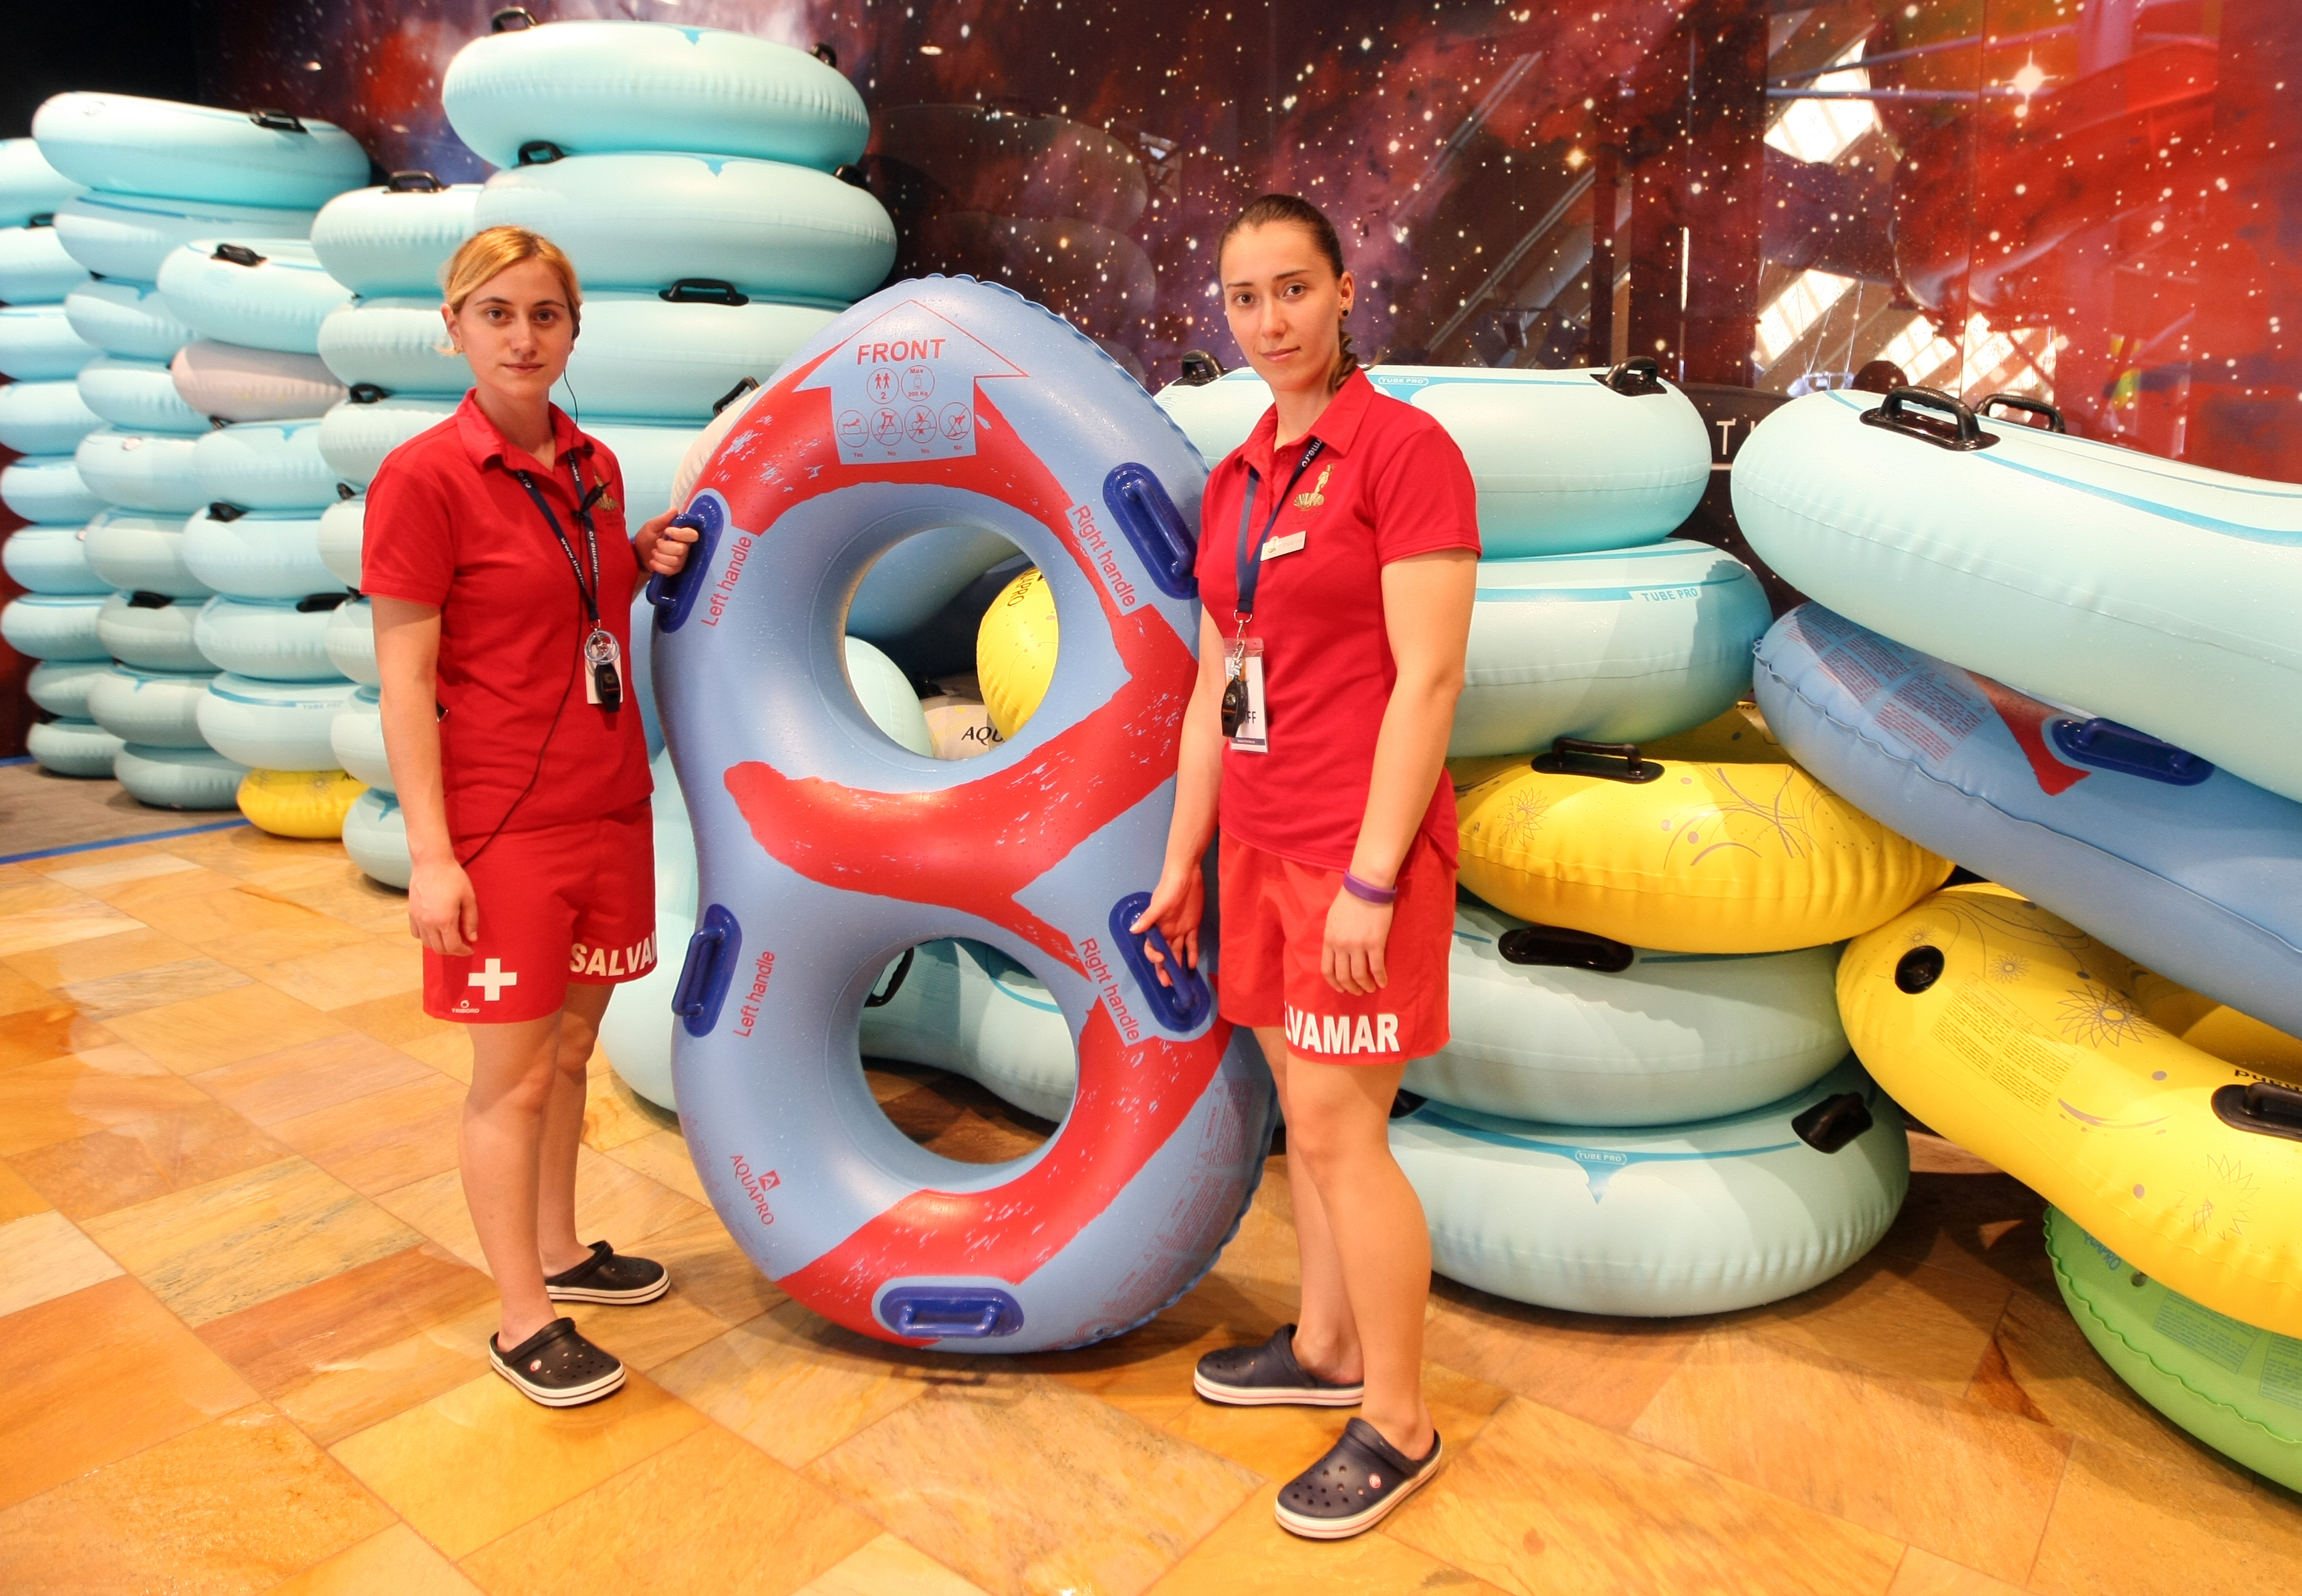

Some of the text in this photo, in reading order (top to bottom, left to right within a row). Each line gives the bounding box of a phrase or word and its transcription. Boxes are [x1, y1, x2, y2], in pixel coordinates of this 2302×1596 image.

[857, 338, 946, 366] FRONT
[880, 392, 886, 400] 2
[700, 536, 752, 627] Left handle
[1072, 505, 1136, 607] Right handle
[1640, 587, 1698, 602] TUBE PRO
[961, 726, 1005, 746] AQU
[733, 950, 775, 1037] Left handle
[1079, 938, 1139, 1041] Right handle
[729, 1155, 774, 1226] AQUAPRO
